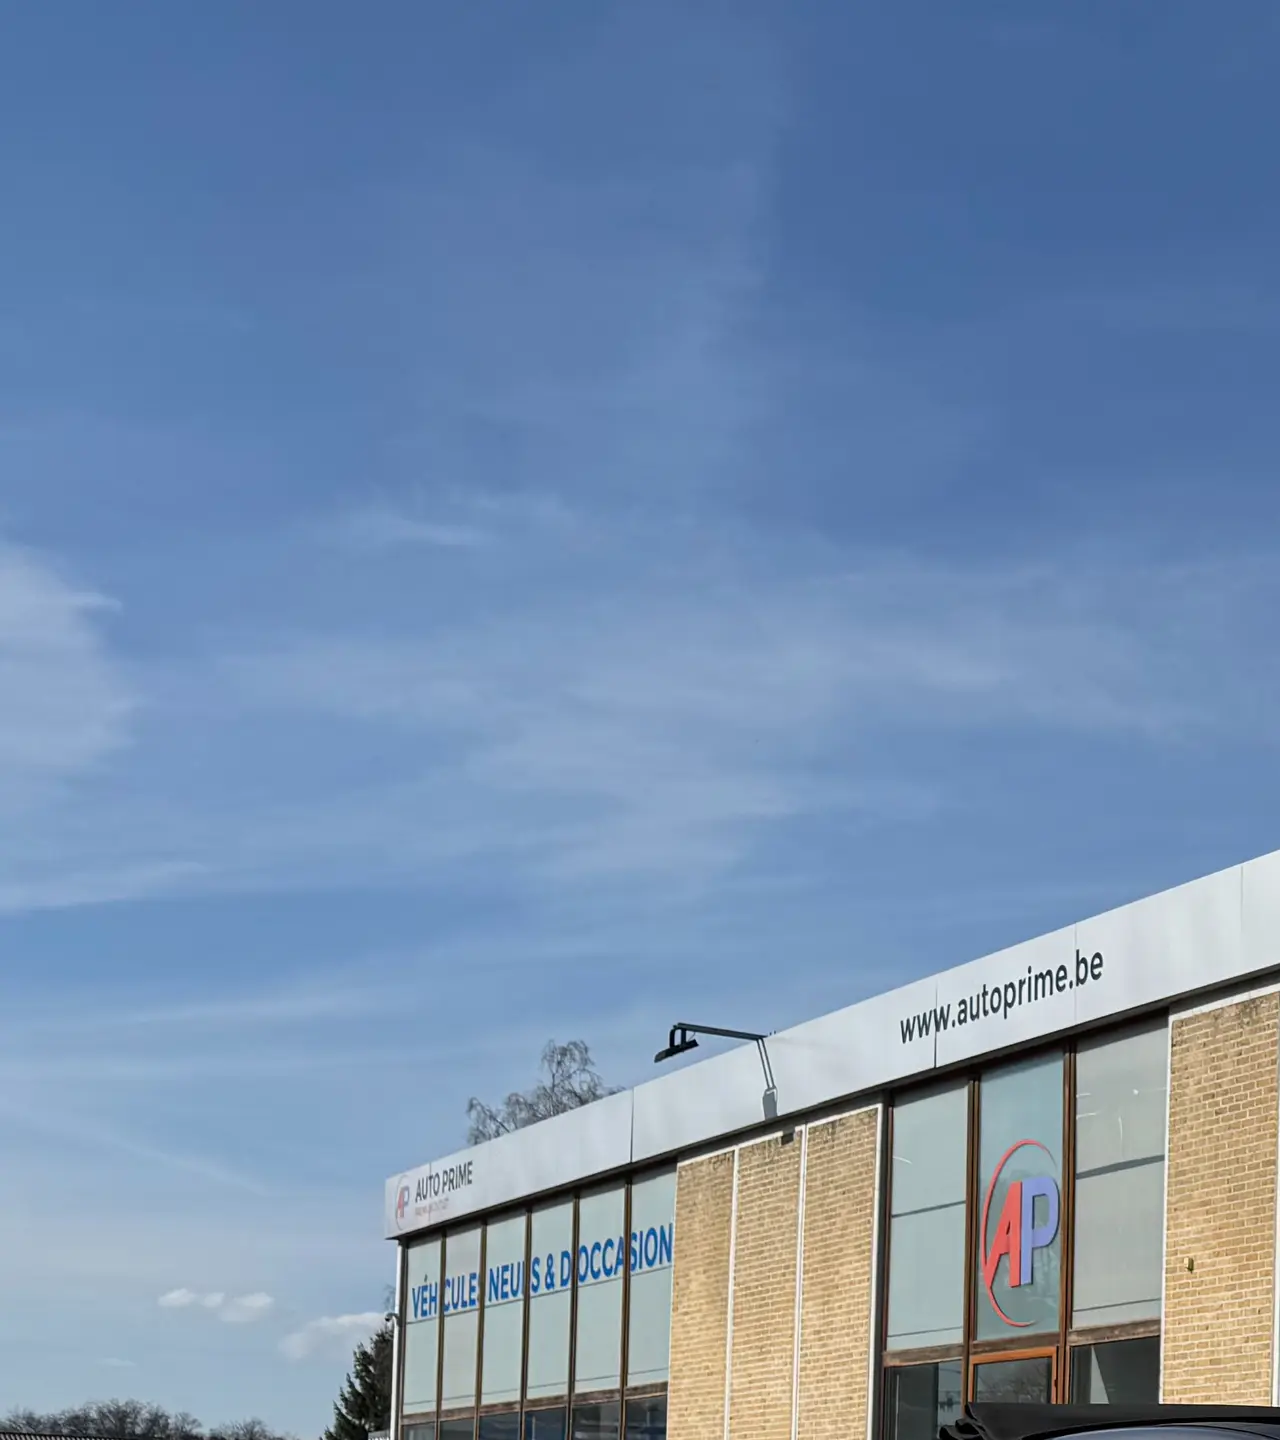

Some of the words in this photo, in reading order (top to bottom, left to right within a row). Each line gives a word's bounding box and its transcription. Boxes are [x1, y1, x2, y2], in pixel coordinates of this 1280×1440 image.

[900, 949, 1104, 1044] www.autoprime.be
[415, 1172, 440, 1203] AUTO
[442, 1160, 473, 1194] PRIME
[412, 1272, 483, 1318] VÉHCULE
[488, 1256, 540, 1303] NEUS
[545, 1253, 555, 1289] &
[560, 1223, 673, 1287] DOCCASION
[983, 1176, 1061, 1289] AP
